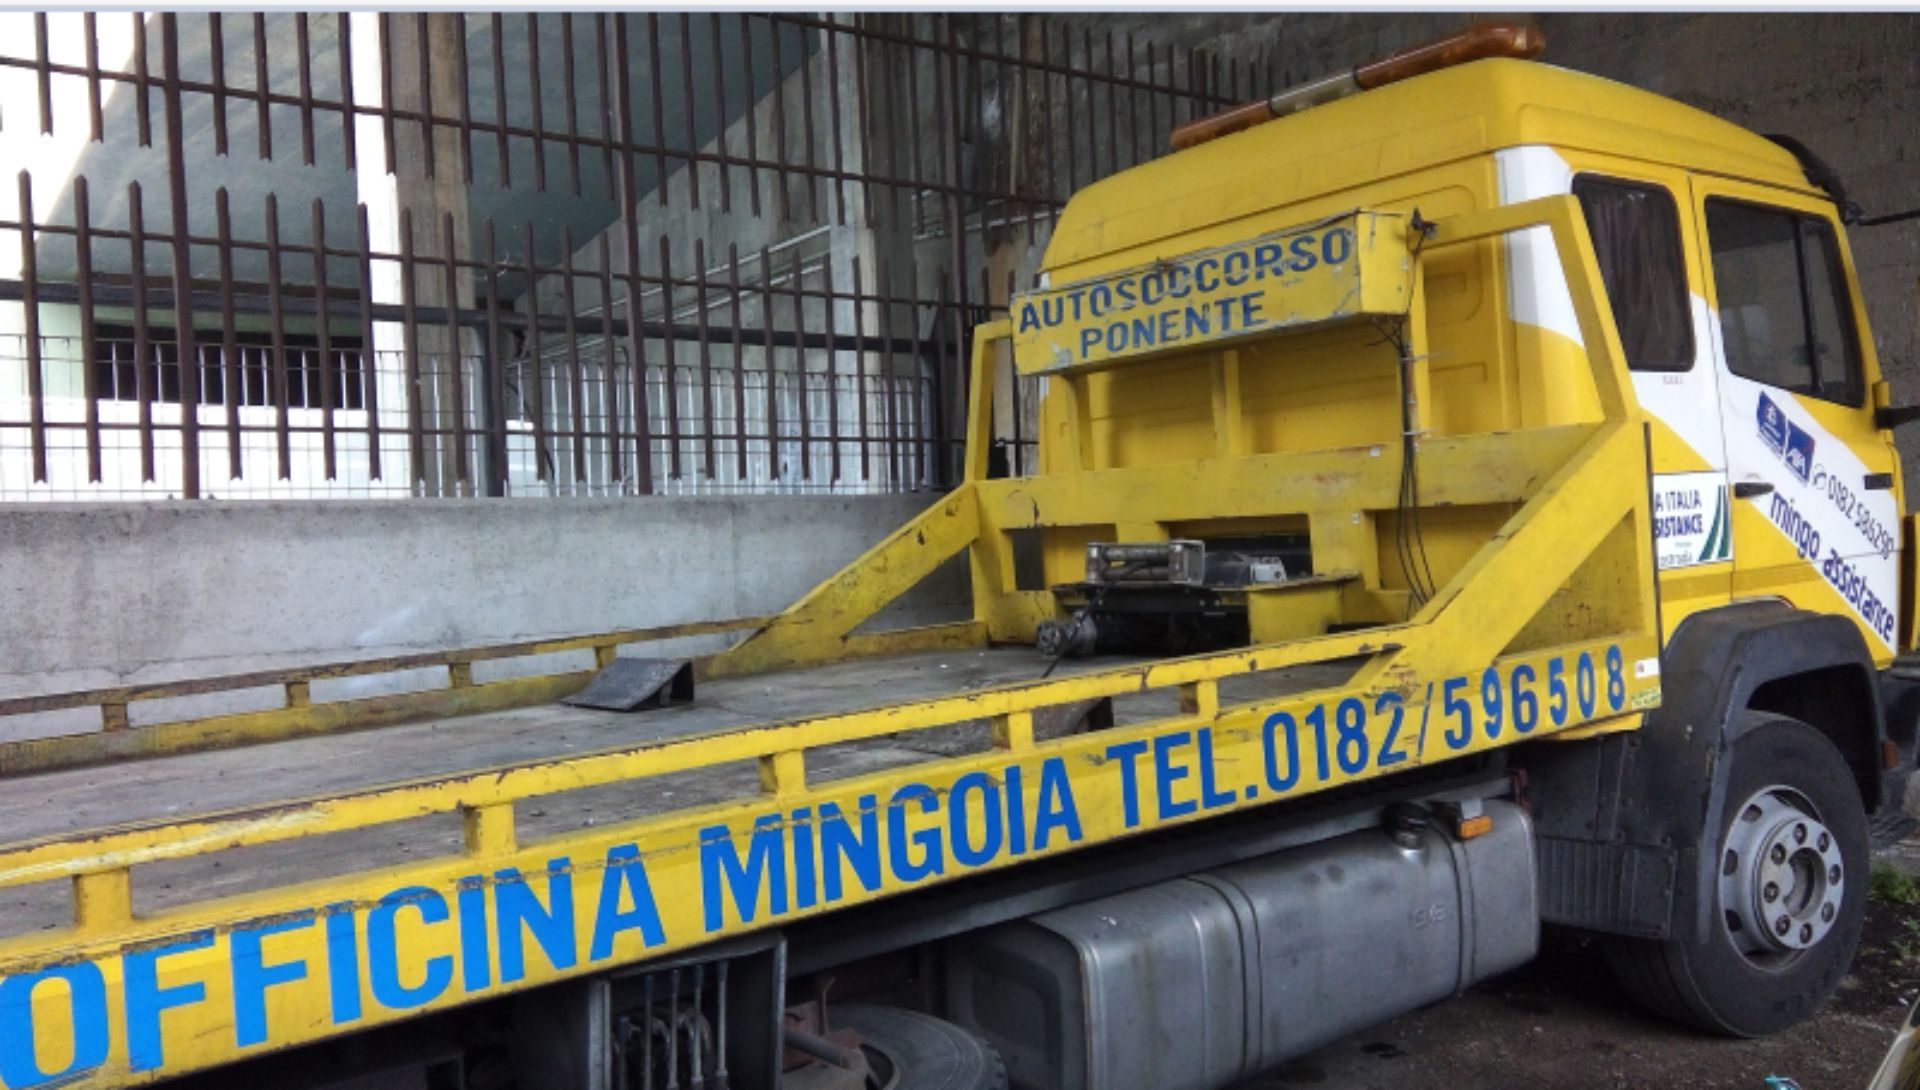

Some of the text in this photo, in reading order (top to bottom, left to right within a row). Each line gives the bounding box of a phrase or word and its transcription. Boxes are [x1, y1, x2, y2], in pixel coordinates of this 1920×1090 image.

[1018, 227, 1351, 334] AUTOSOCCORSO
[1080, 290, 1266, 359] PONENTE
[1665, 489, 1703, 512] ITALIA
[1770, 491, 1820, 560] mingo
[1823, 547, 1895, 642] assistance
[0, 842, 666, 1090] OFFICINA
[699, 757, 1083, 932] MINGOIA
